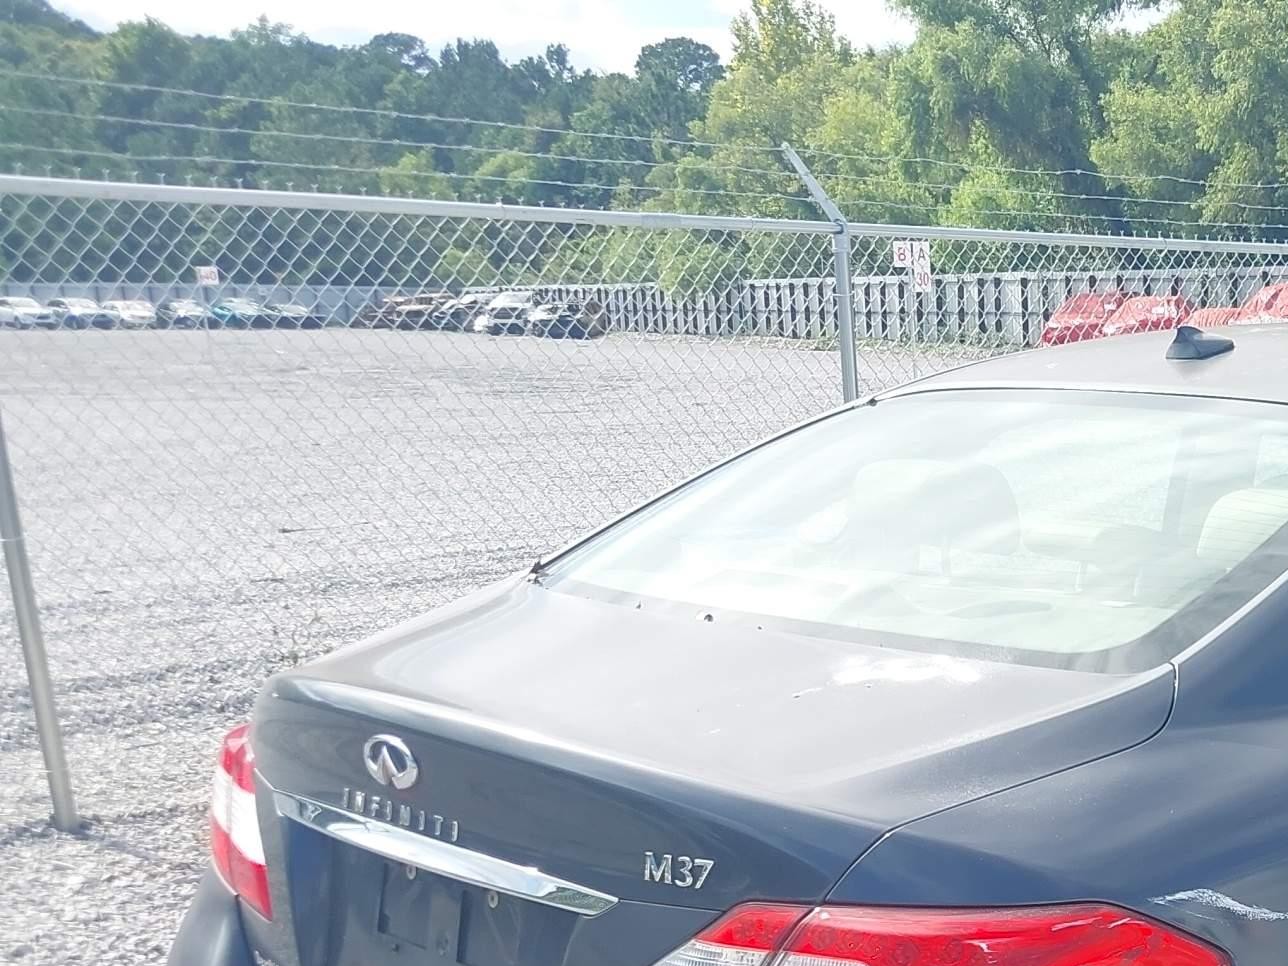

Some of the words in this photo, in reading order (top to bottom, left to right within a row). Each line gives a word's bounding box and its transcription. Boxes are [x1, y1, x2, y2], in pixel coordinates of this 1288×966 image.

[917, 247, 927, 262] A
[343, 787, 460, 842] INFINITI
[644, 851, 715, 889] M37
